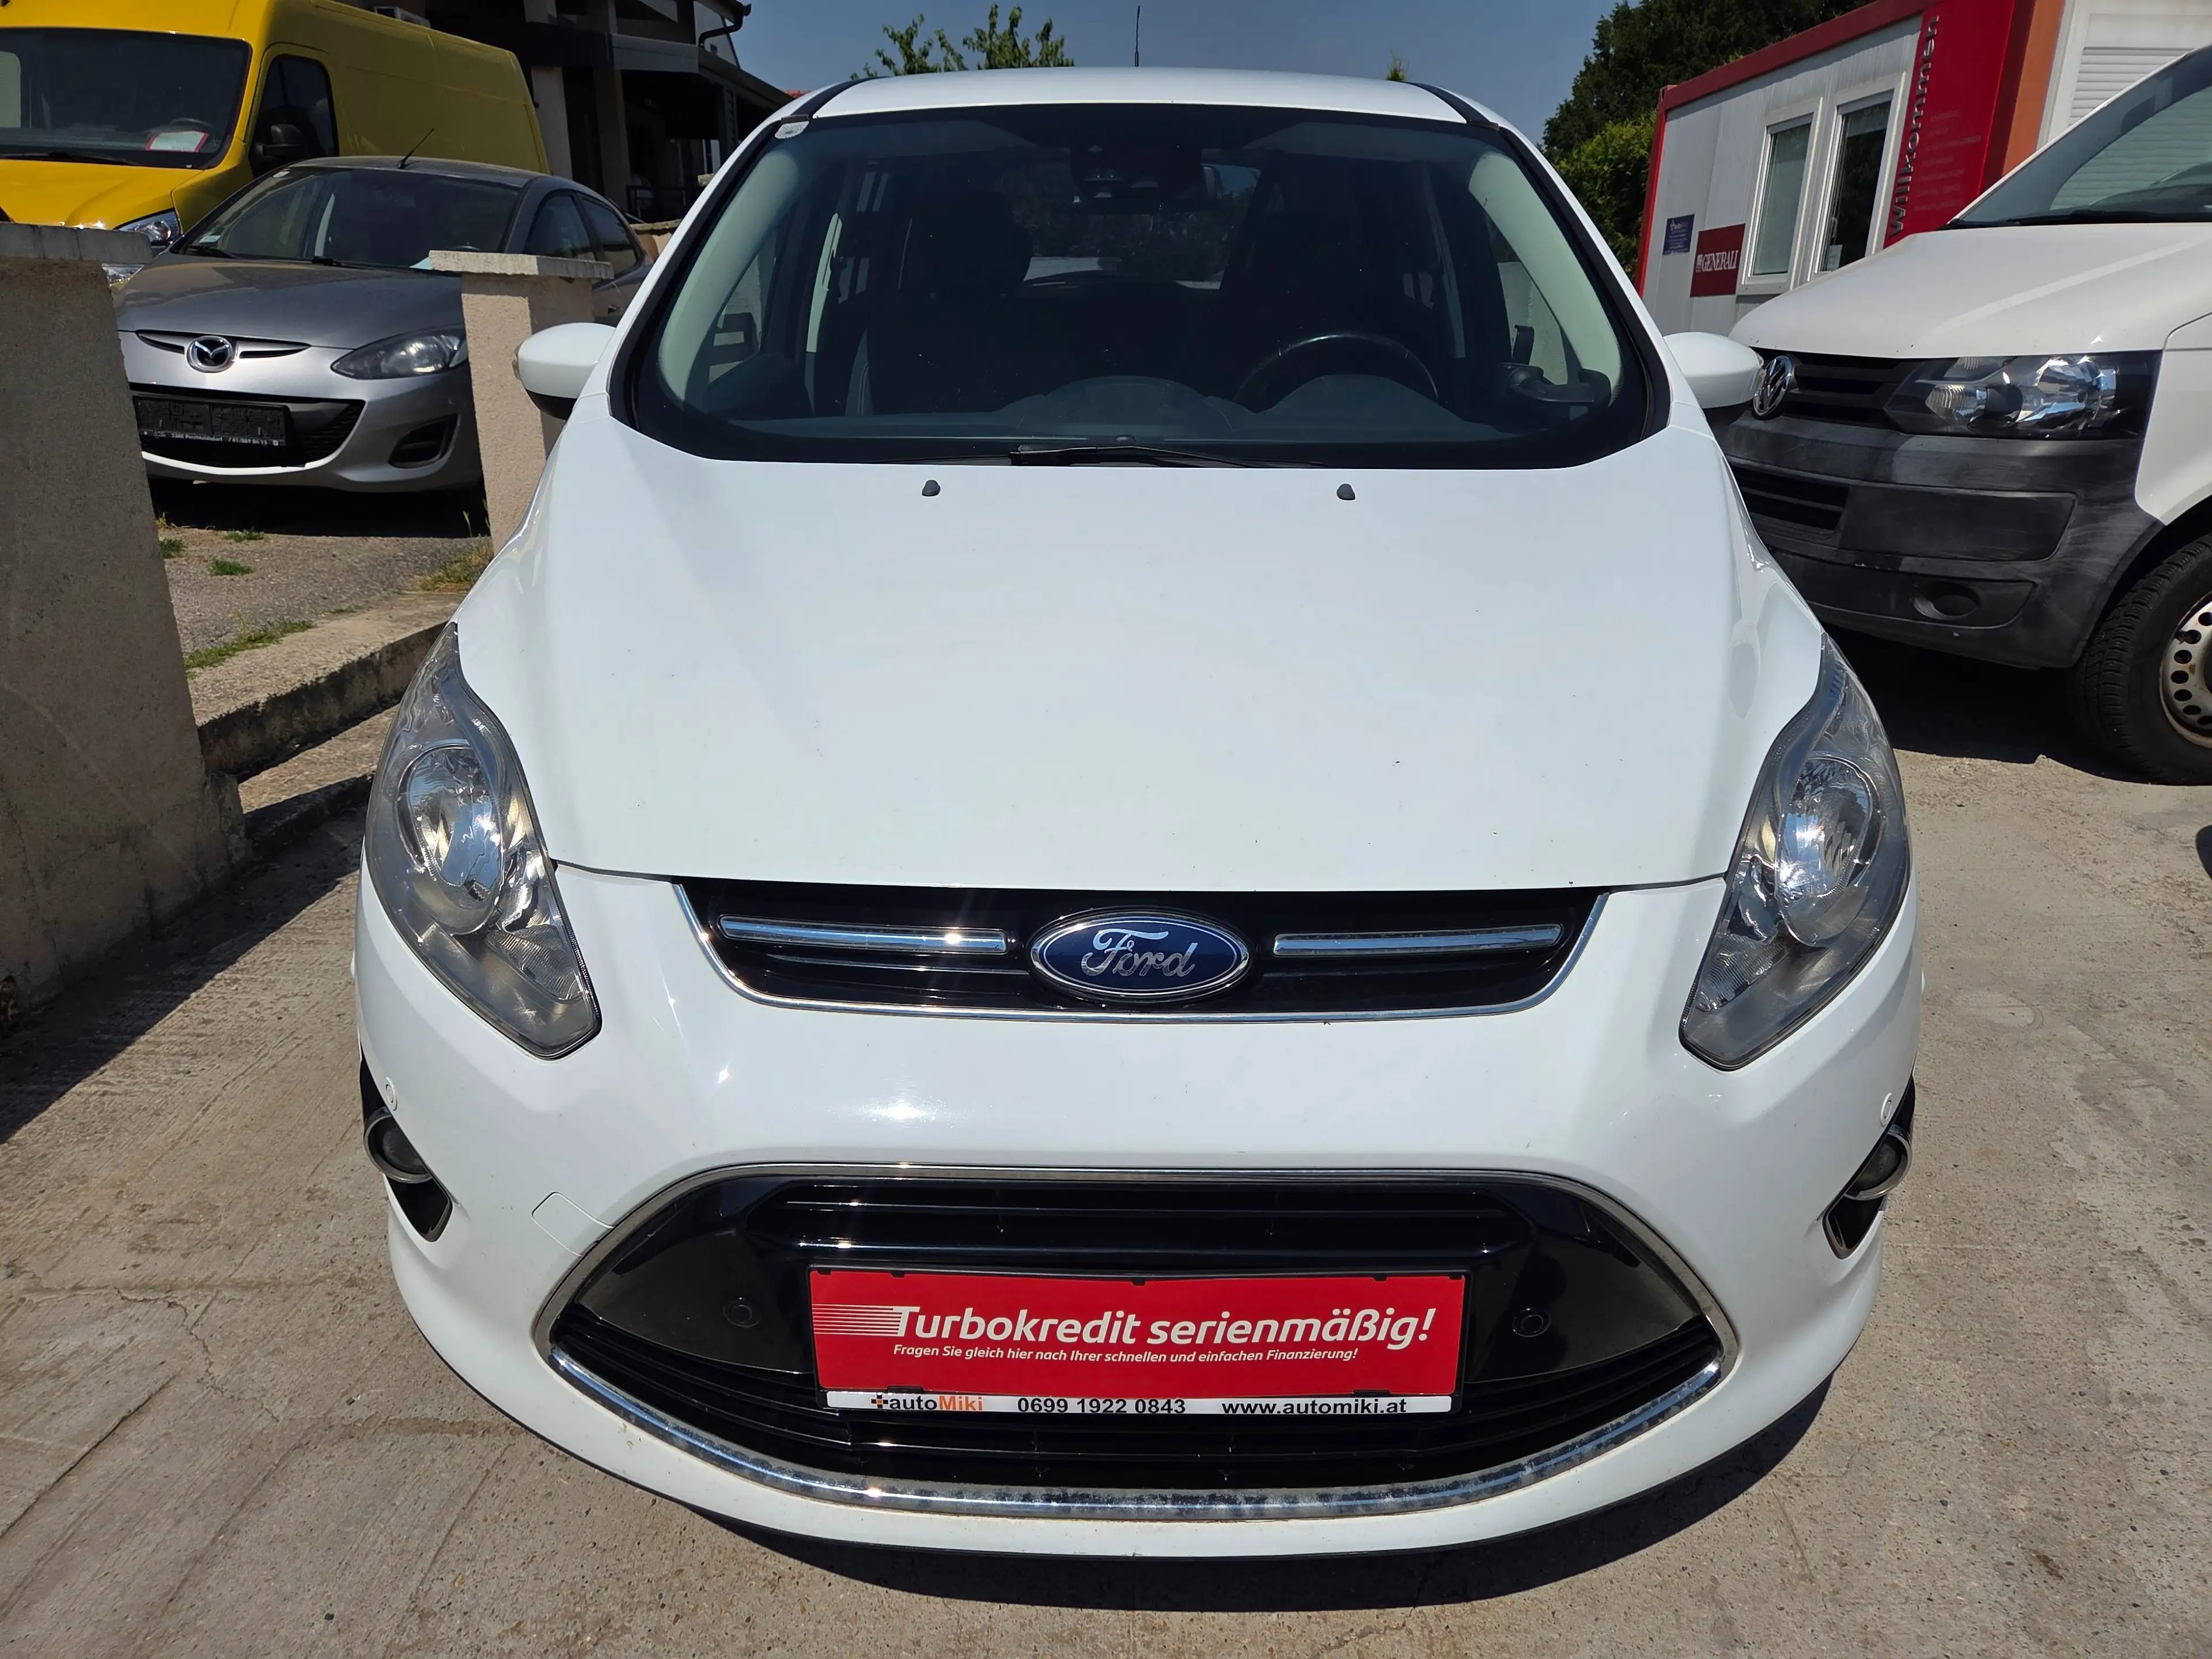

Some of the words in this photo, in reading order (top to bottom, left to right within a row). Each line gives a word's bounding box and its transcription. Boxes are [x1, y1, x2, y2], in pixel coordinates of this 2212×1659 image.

[1702, 250, 1738, 272] GENERALI
[1081, 928, 1198, 977] Ford
[893, 1306, 1140, 1344] Turbokredit
[1146, 1308, 1436, 1350] serienmäßig!
[893, 1344, 939, 1358] Fragen
[942, 1346, 962, 1357] Sie
[965, 1347, 1003, 1359] gleich
[1007, 1348, 1033, 1359] hier
[1036, 1349, 1067, 1361] nach
[1070, 1350, 1102, 1361] Ihrer
[1105, 1350, 1166, 1362] schnellen
[1170, 1350, 1195, 1362] und
[1198, 1349, 1263, 1362] einfachen
[1266, 1348, 1358, 1362] Finanzierung!
[889, 1395, 983, 1411] autoMiki
[1017, 1397, 1069, 1414] 0699
[1077, 1397, 1127, 1414] 1922
[1134, 1398, 1186, 1414] 0843
[1221, 1398, 1407, 1415] www.automiki.at
